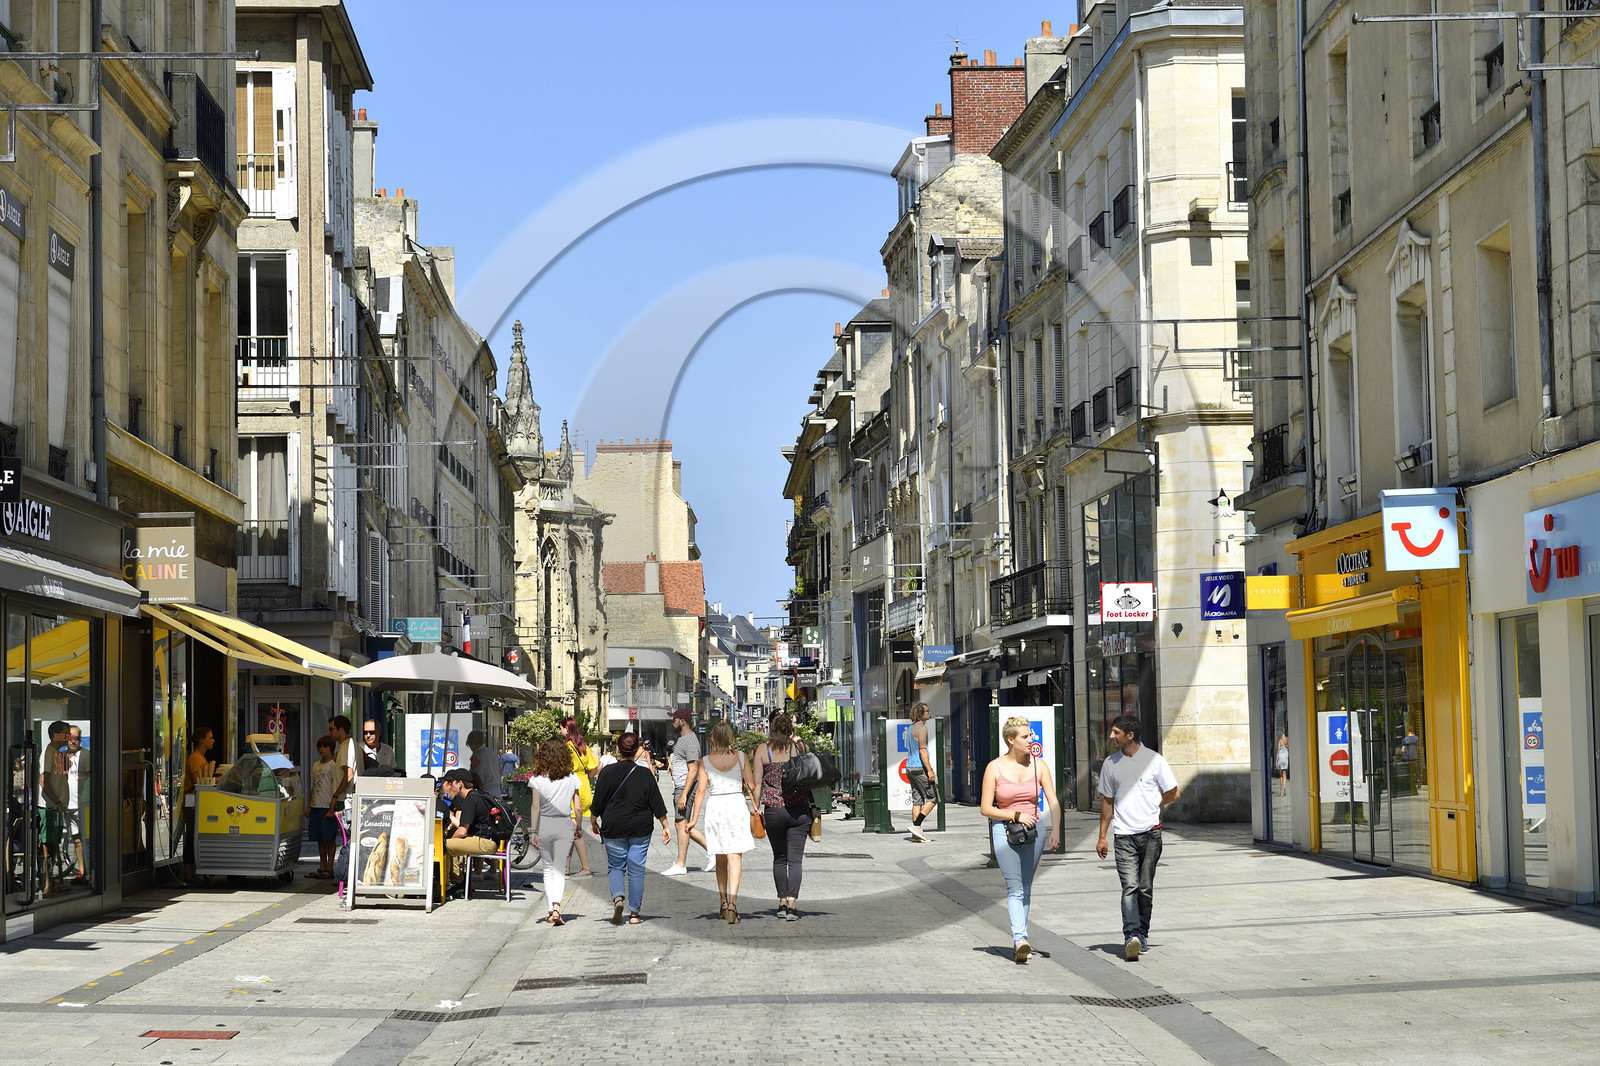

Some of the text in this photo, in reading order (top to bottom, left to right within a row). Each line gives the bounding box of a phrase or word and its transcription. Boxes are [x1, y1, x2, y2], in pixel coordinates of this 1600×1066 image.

[7, 203, 21, 228] AIGLE
[57, 246, 70, 267] AIGLE
[15, 499, 51, 541] AIGLE
[124, 539, 189, 559] la mie
[123, 560, 188, 580] CÂLINE
[1124, 610, 1149, 618] Locker
[1031, 746, 1040, 754] 20
